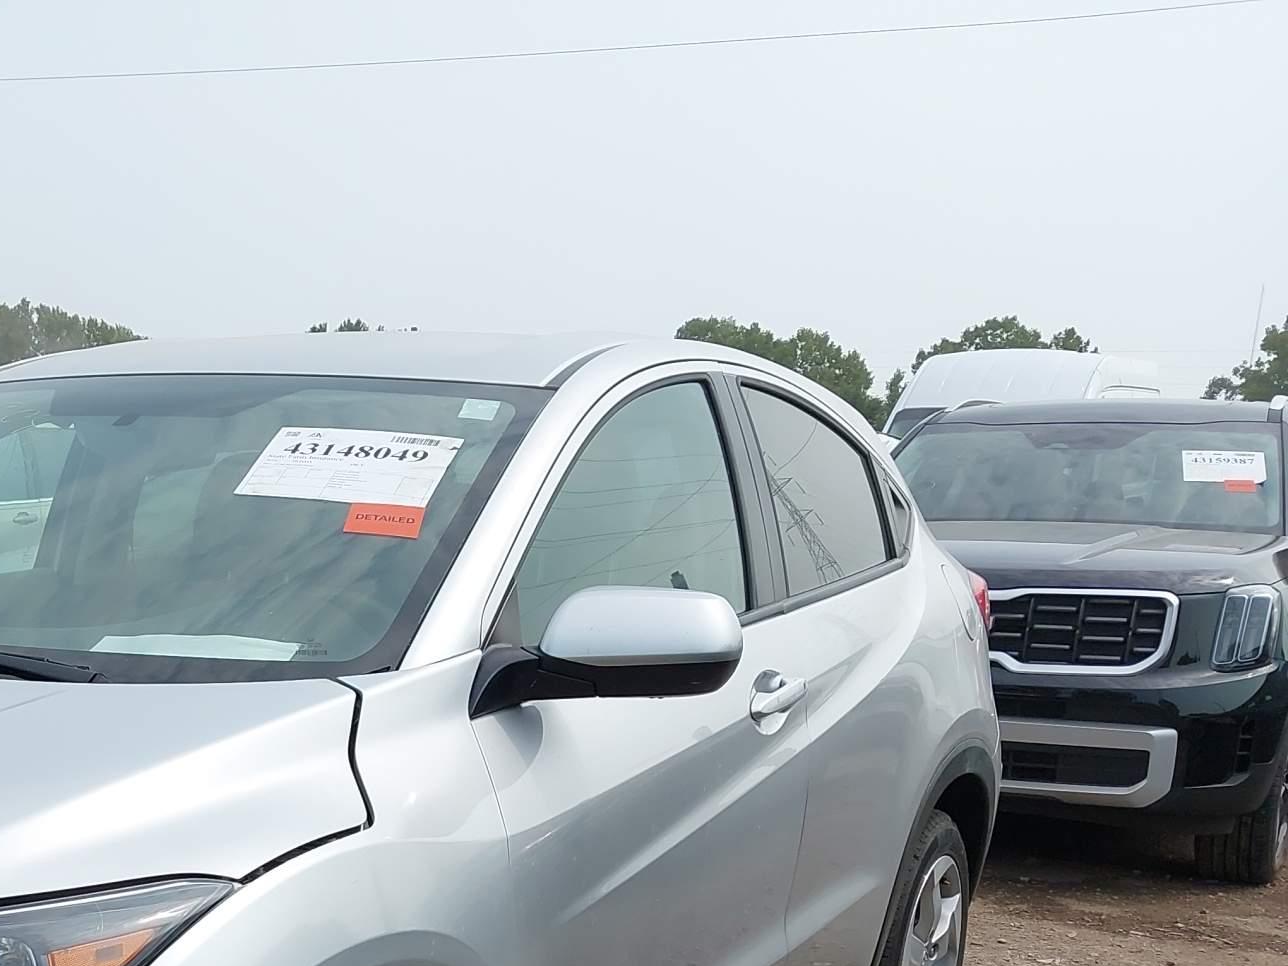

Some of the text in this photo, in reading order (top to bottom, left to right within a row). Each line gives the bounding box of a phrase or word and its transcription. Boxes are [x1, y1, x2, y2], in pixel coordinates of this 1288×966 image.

[283, 441, 429, 463] 43148049
[1191, 457, 1255, 465] 43159387
[355, 513, 416, 524] DETAILED
